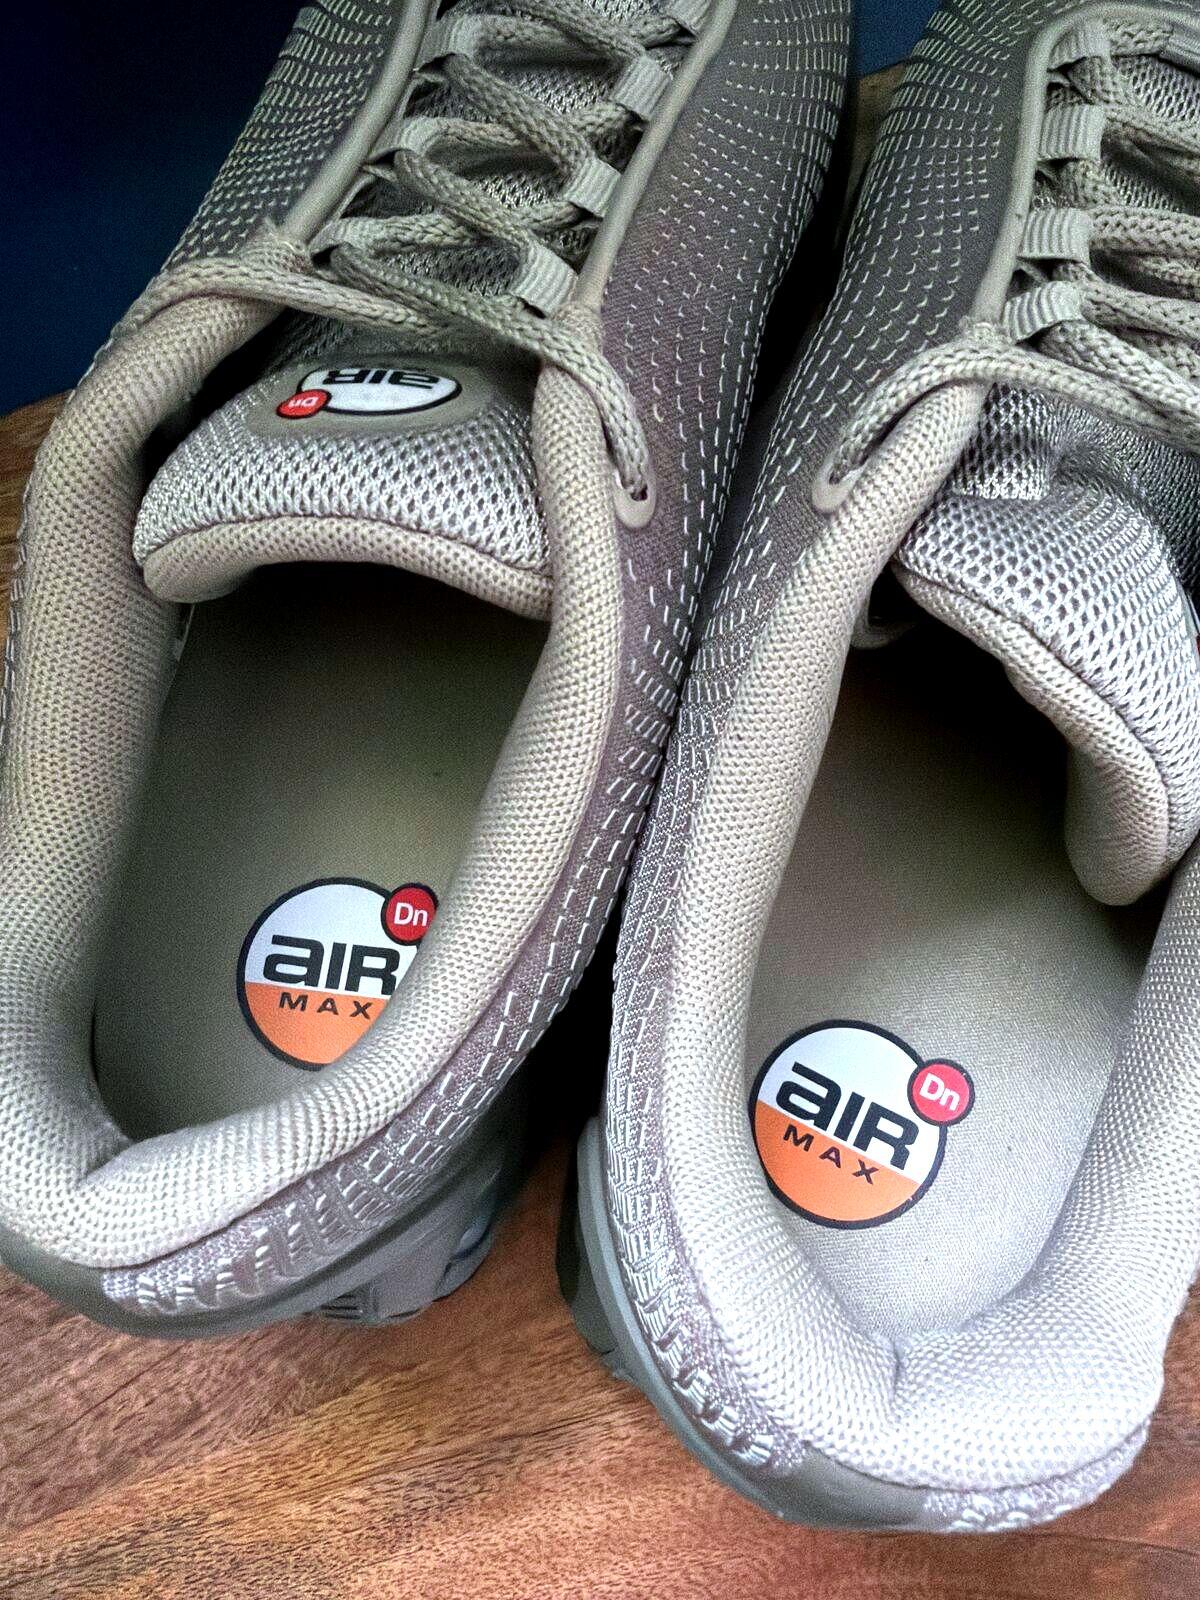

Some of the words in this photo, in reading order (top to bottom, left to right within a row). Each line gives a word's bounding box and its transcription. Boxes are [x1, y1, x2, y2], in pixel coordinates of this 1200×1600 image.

[393, 902, 429, 927] Dn
[278, 991, 373, 1019] MAX
[919, 1072, 960, 1111] Dn
[782, 1124, 879, 1185] MAX
